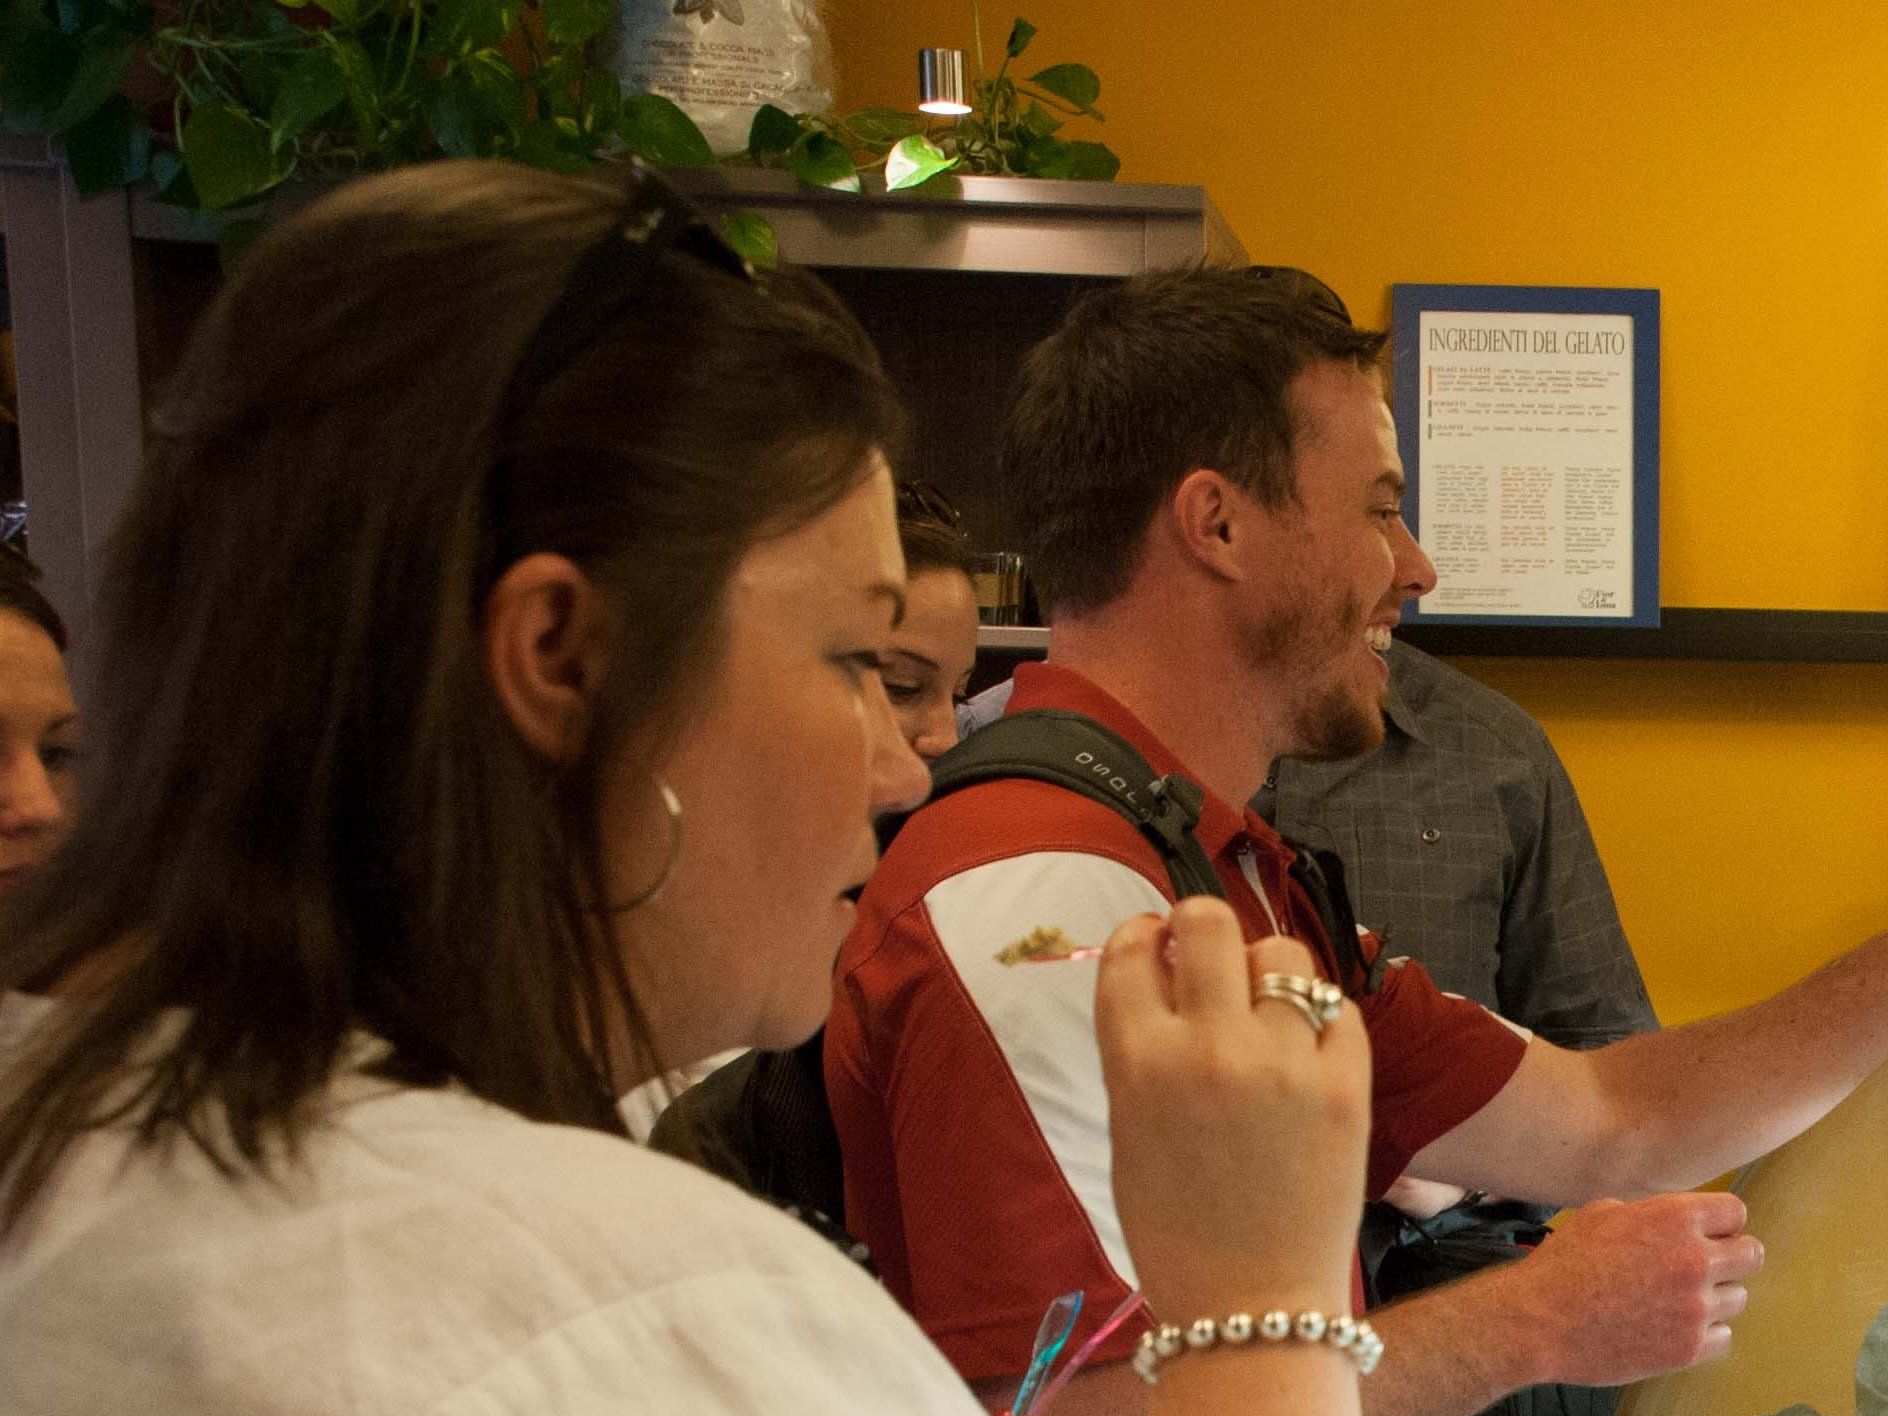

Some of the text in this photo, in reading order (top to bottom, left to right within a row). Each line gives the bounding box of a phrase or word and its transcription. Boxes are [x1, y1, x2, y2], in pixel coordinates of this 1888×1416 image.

[1428, 328, 1625, 355] INGREDIENTI DEL GELATO
